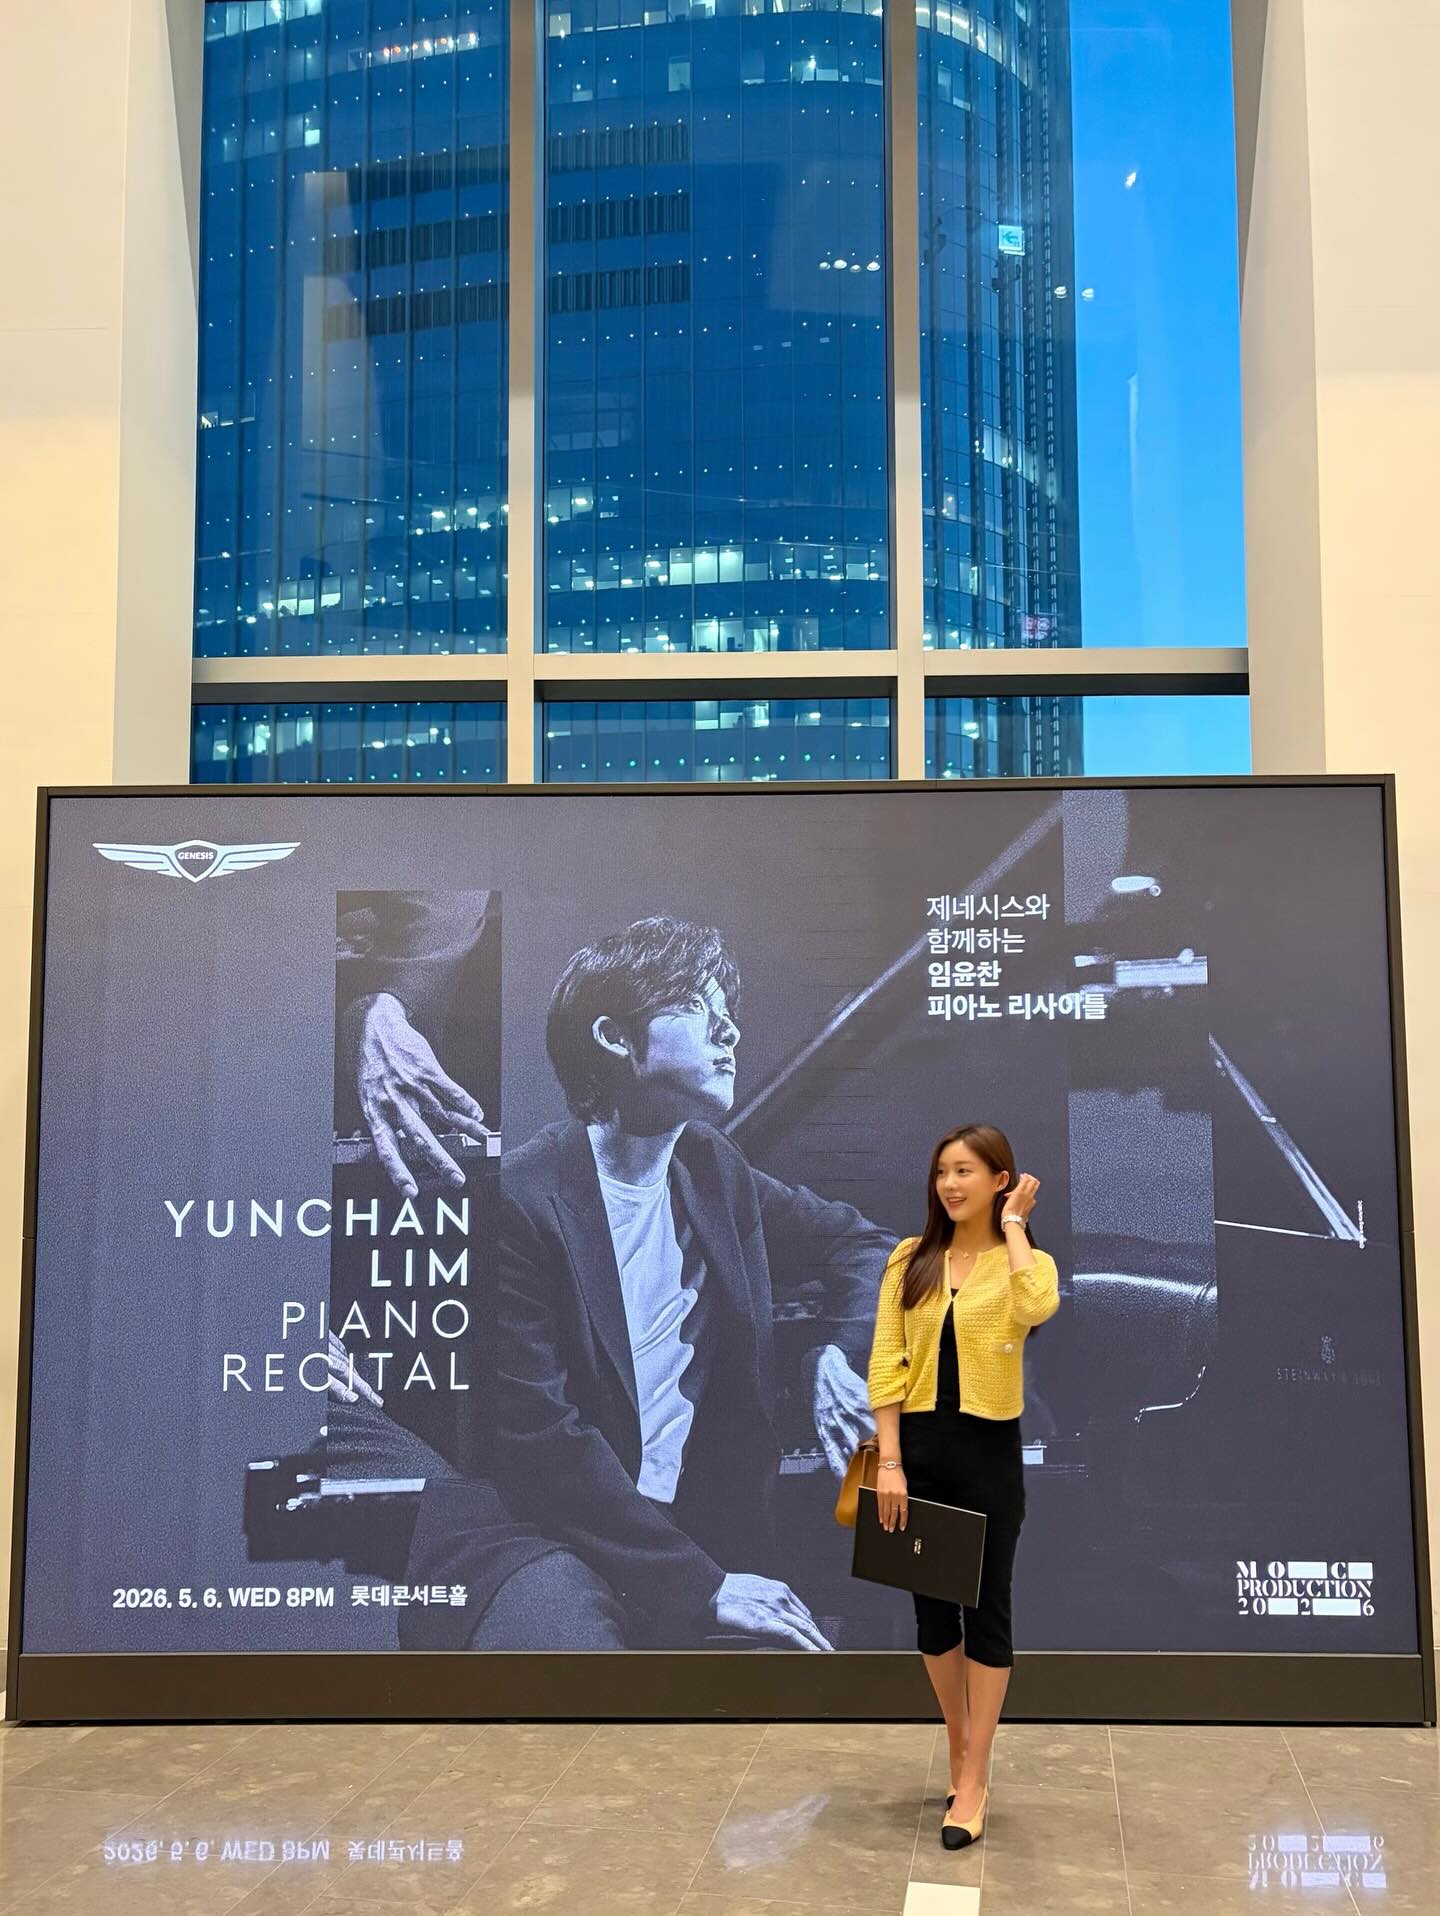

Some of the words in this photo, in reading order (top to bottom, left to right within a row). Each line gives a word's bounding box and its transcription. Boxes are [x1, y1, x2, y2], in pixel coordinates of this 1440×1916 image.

[178, 851, 214, 860] GENESIS
[927, 894, 1050, 921] 제네시스와
[927, 927, 1026, 954] 함께하는
[928, 960, 1002, 987] 임윤찬
[928, 993, 1002, 1021] 피아노
[1008, 992, 1108, 1020] 리사이틀
[164, 1197, 469, 1237] YUNCHAN
[371, 1248, 468, 1287] LIM
[282, 1299, 469, 1340] PIANO
[222, 1351, 469, 1392] RECITAL
[112, 1588, 172, 1608] 2026.
[178, 1588, 198, 1608] 5.
[203, 1588, 222, 1608] 6.
[228, 1587, 281, 1608] WED
[286, 1587, 334, 1607] 8PM
[350, 1585, 468, 1606] 롯데콘서트홀
[1237, 1579, 1373, 1598] PRODUCTION
